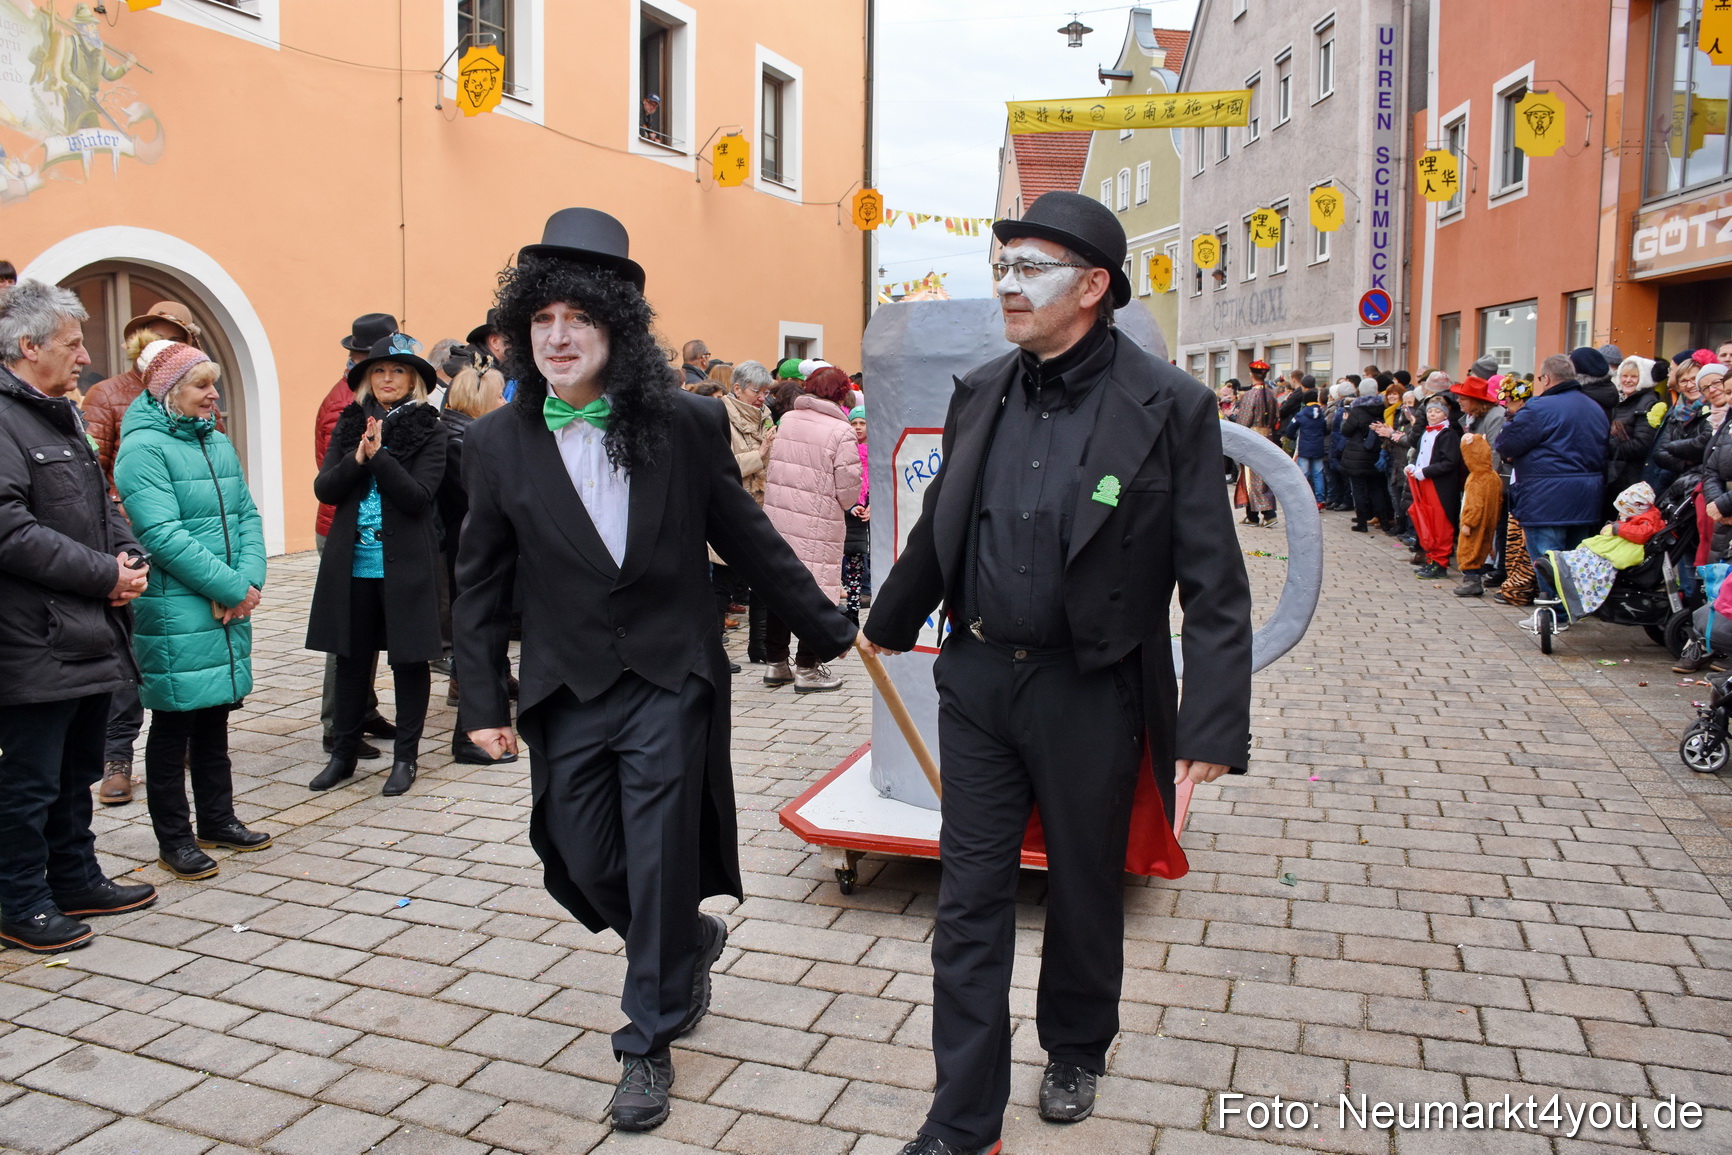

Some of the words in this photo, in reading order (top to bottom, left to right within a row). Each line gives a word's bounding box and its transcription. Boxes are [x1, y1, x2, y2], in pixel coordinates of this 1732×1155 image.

[1378, 27, 1394, 130] UHREN
[66, 130, 119, 152] Winter
[1372, 146, 1390, 290] SCHMUCK
[1213, 296, 1247, 331] OPTIK
